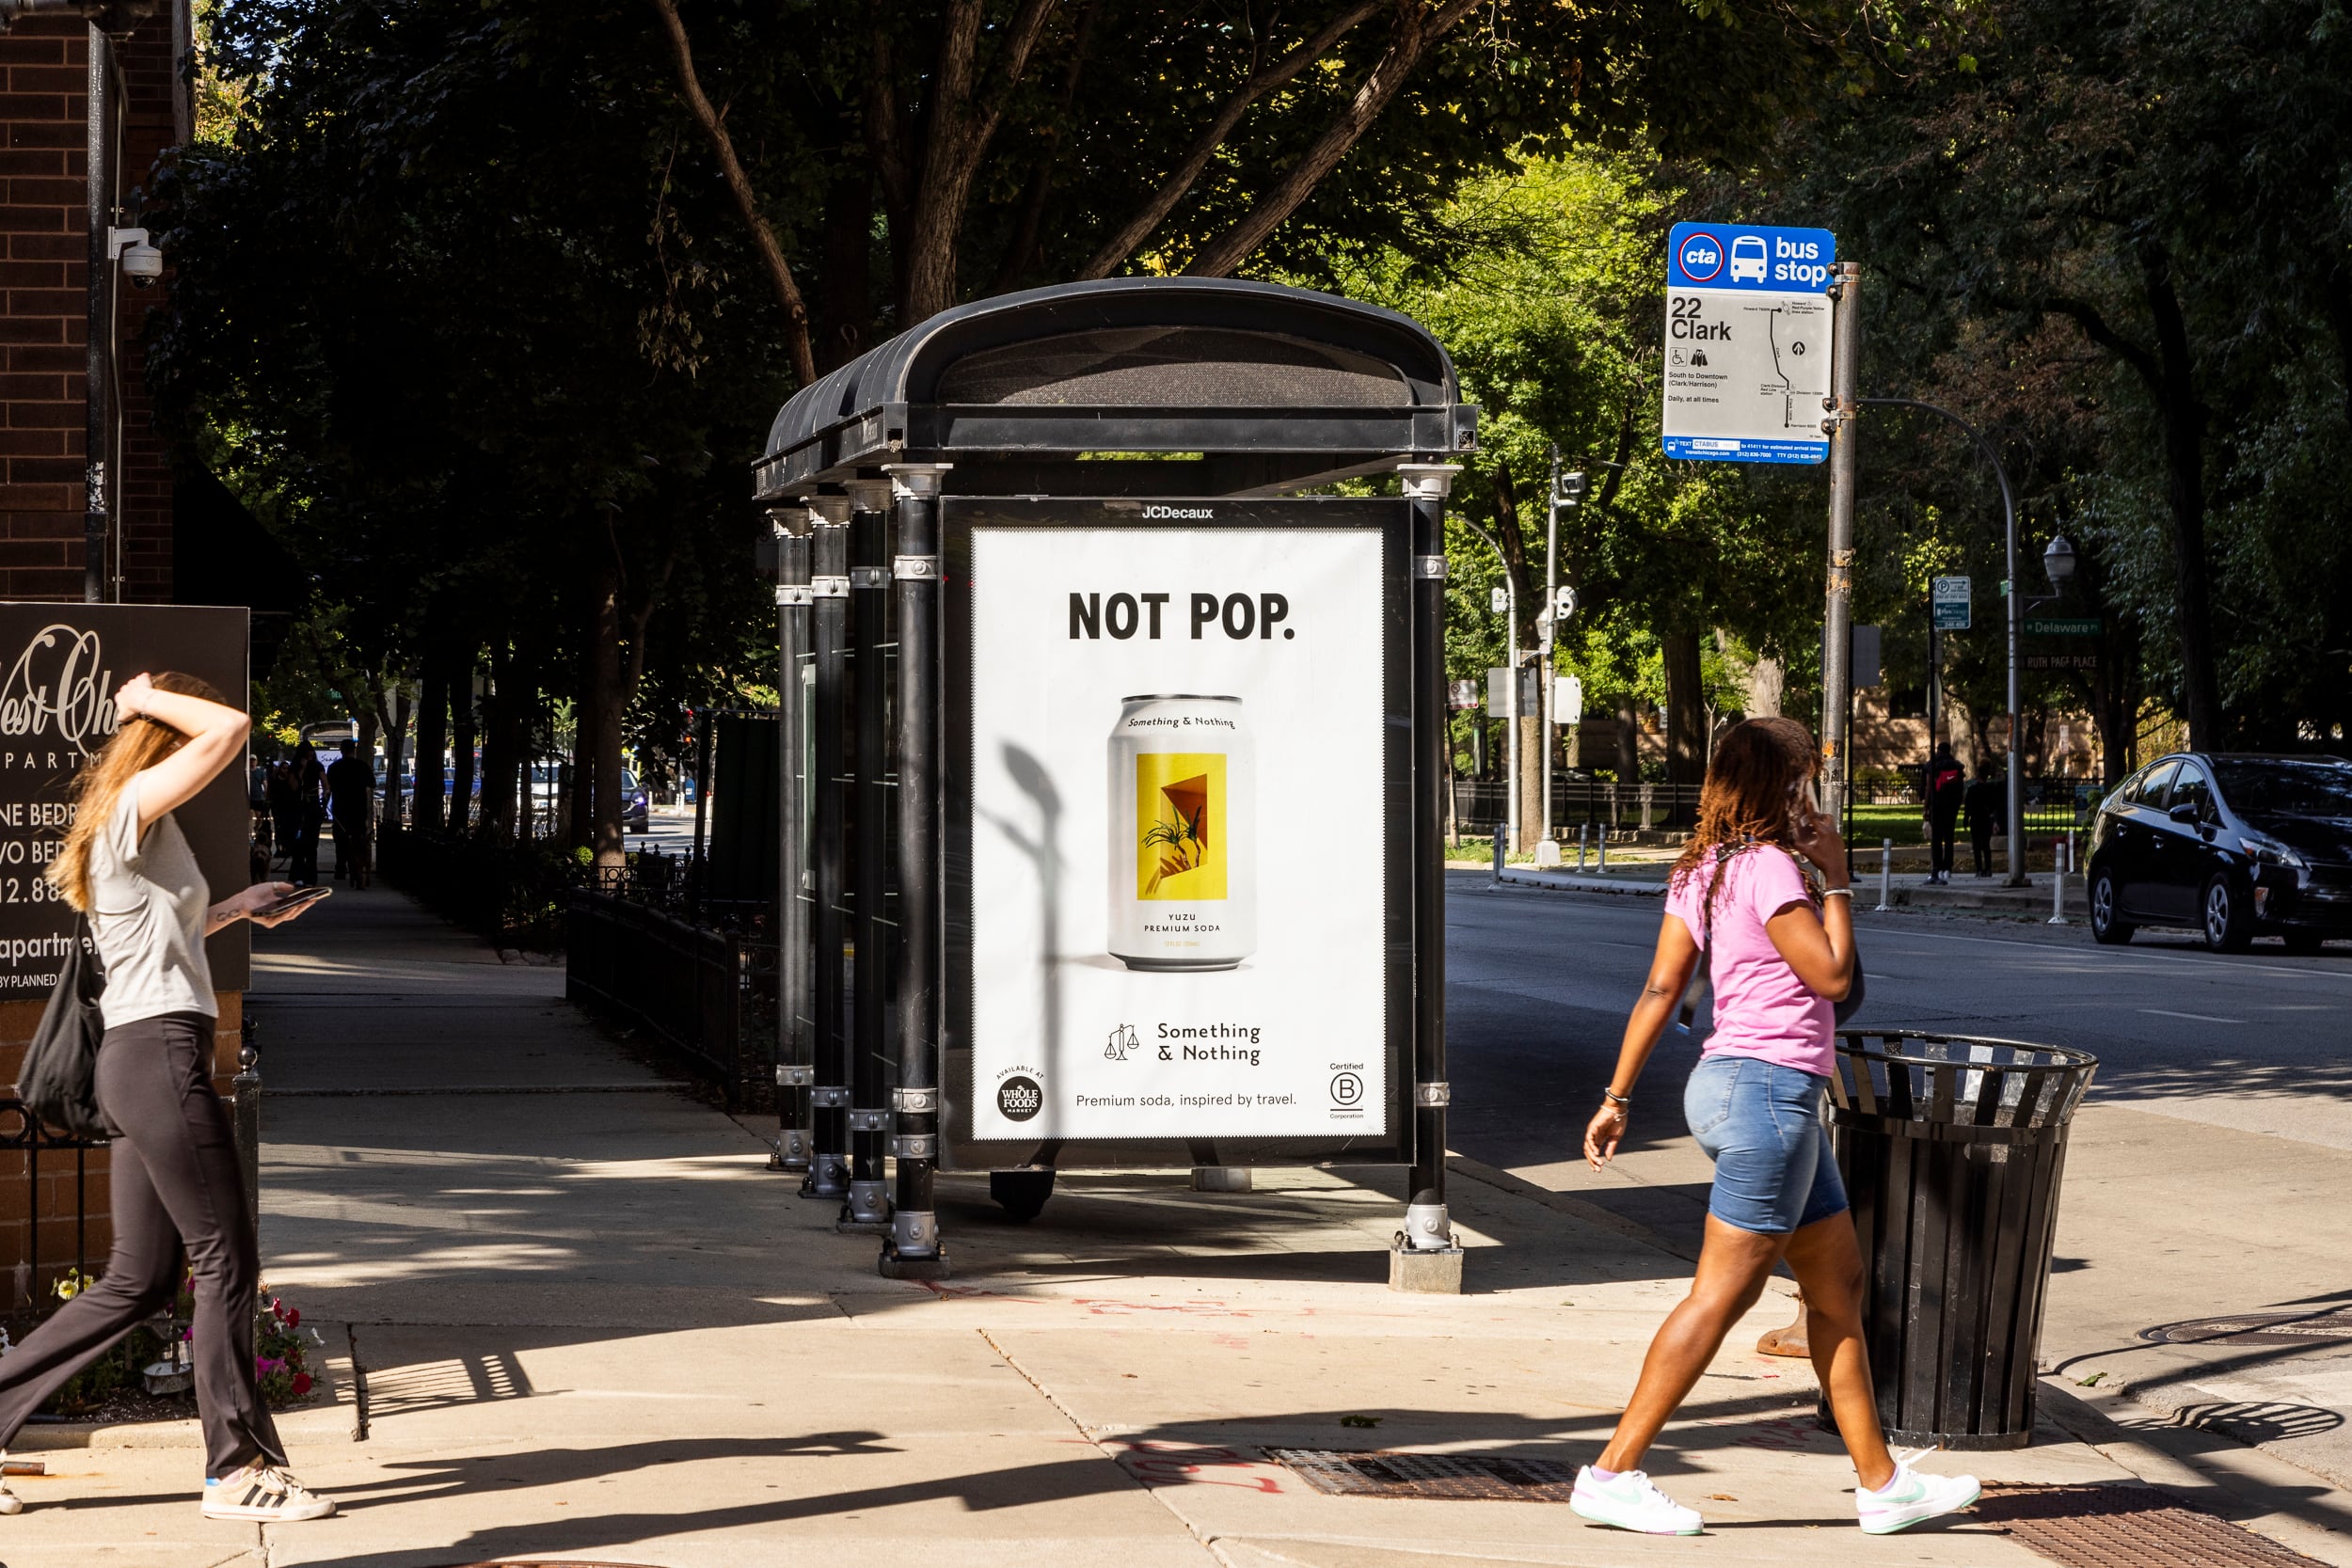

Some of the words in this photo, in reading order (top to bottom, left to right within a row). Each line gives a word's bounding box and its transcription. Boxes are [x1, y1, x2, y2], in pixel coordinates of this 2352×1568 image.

[1776, 236, 1819, 260] bus
[1686, 248, 1716, 264] cta
[1774, 261, 1826, 287] stop
[1672, 297, 1702, 318] 22
[1672, 319, 1732, 341] Clark
[1668, 380, 1718, 388] (Clark/Harrison)
[1667, 395, 1685, 404] Daily,
[1142, 506, 1214, 518] JCDecaux
[1069, 593, 1169, 640] NOT
[1190, 593, 1295, 640] POP.
[2035, 622, 2089, 633] Delaware
[2026, 656, 2048, 668] RUTH
[2073, 656, 2098, 668] PLACE
[1128, 717, 1180, 728] Something
[1183, 717, 1191, 725] &
[1195, 717, 1236, 729] Nothing
[11, 974, 57, 988] PLANNED
[1158, 1022, 1261, 1044] Something
[1158, 1045, 1173, 1061] &
[1183, 1045, 1261, 1067] Nothing
[996, 1065, 1035, 1080] AVAILABLE
[1035, 1071, 1044, 1080] AT
[1001, 1089, 1038, 1099] WHOLE
[1340, 1079, 1355, 1098] B
[1004, 1099, 1038, 1108] FOODS
[1076, 1095, 1135, 1106] Premium
[1139, 1094, 1174, 1107] soda,
[1180, 1093, 1232, 1108] inspired
[1237, 1093, 1252, 1107] by
[1257, 1093, 1296, 1105] travel.
